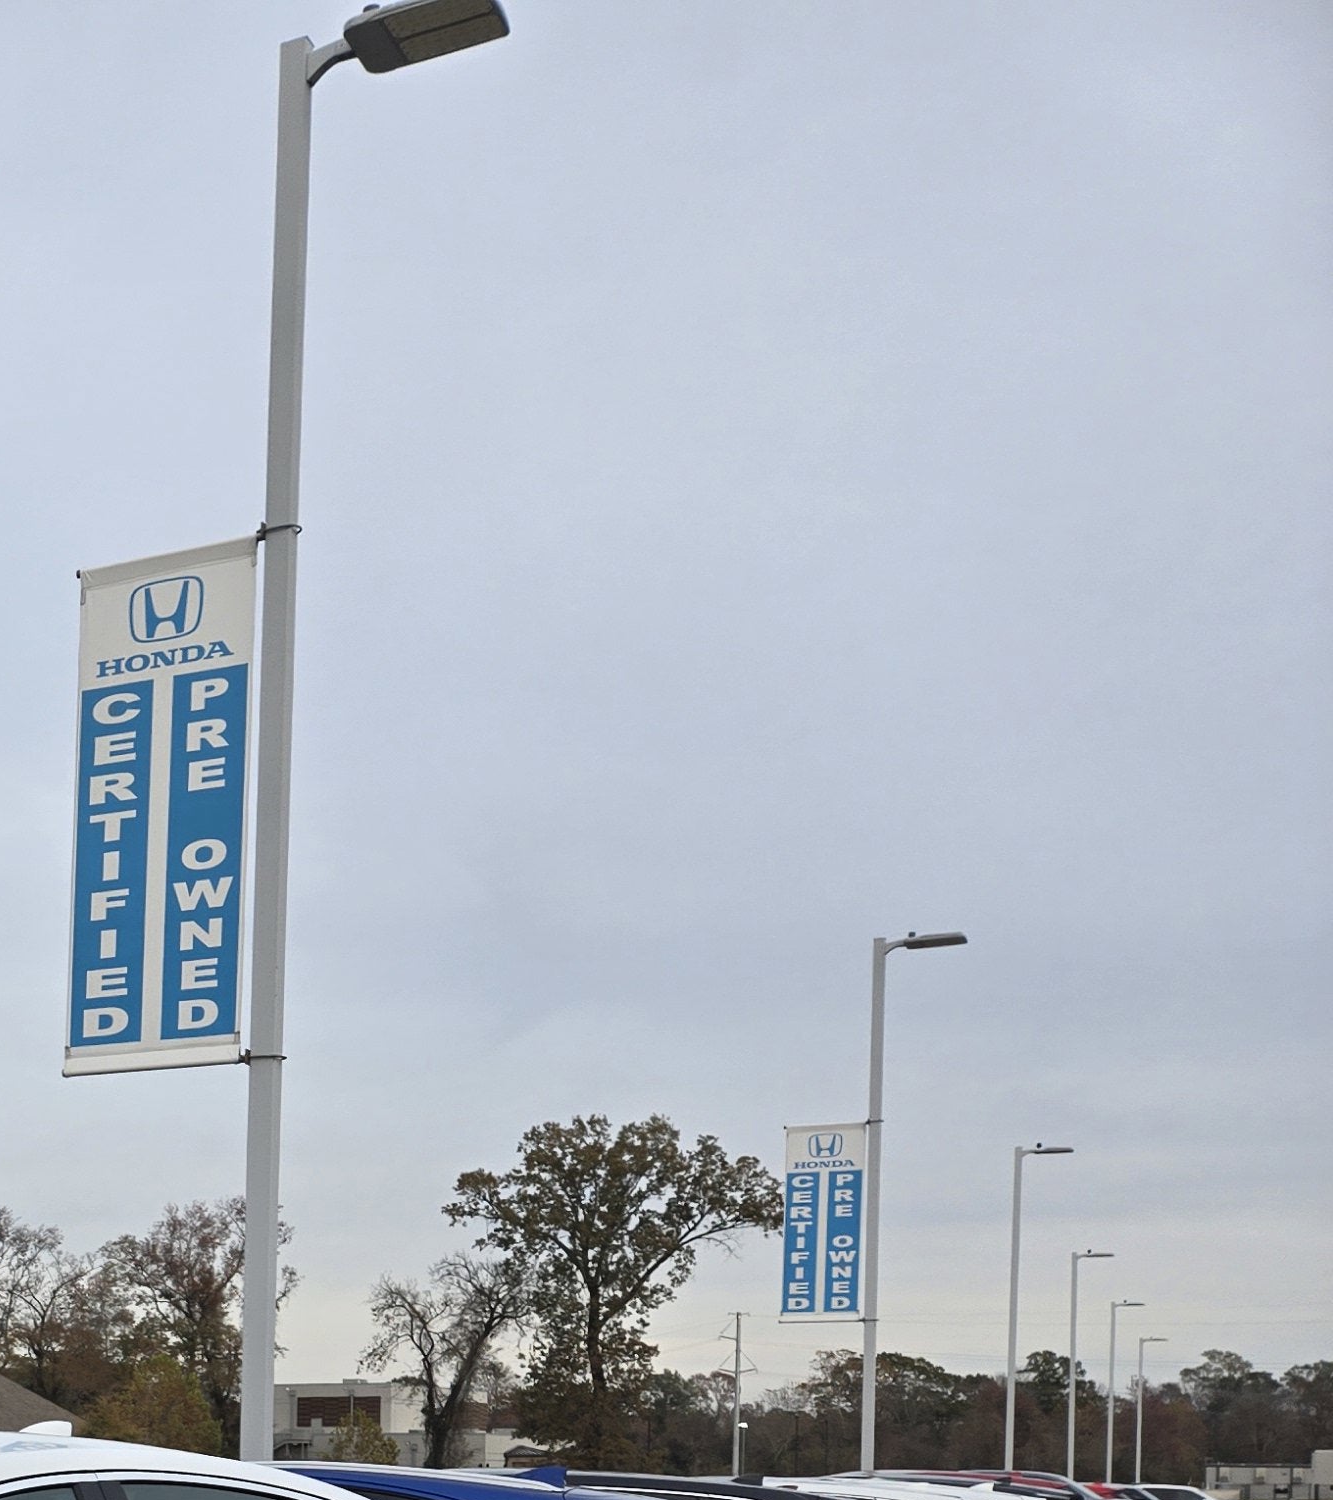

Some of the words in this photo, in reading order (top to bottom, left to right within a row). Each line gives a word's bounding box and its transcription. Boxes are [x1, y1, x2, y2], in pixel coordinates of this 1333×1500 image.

[96, 640, 234, 678] HONDA
[185, 677, 230, 792] PRE
[82, 692, 142, 1039] CERTIFIED
[173, 838, 233, 1031] OWNED
[793, 1159, 855, 1169] HONDA
[834, 1173, 854, 1217] PRE
[787, 1175, 814, 1310] CERTIFIED
[828, 1235, 856, 1310] OWNED
